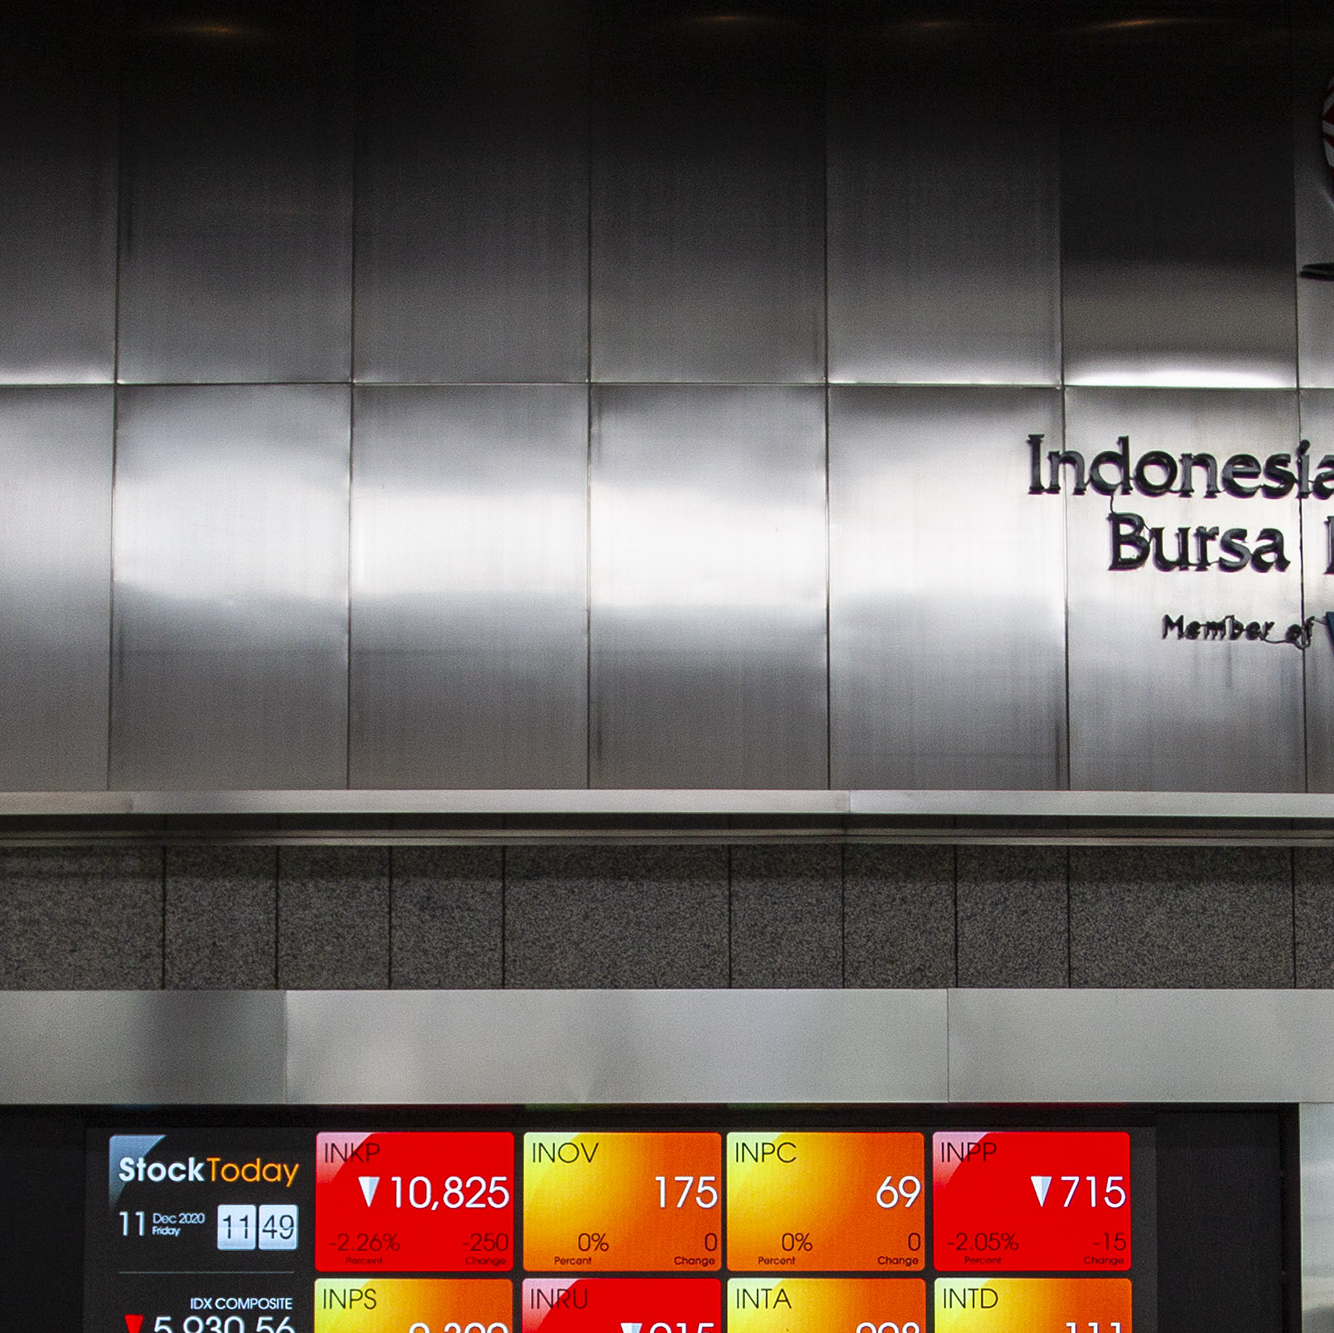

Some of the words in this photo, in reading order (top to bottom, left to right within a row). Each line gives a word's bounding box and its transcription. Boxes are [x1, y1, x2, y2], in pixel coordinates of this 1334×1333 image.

[1109, 512, 1290, 574] Bursa
[1162, 614, 1274, 640] Member
[1285, 617, 1313, 647] of
[324, 1143, 380, 1163] INKP
[532, 1142, 598, 1164] INOV
[735, 1142, 797, 1164] INPC
[940, 1142, 997, 1164] INPP
[391, 1176, 509, 1211] 10,825
[655, 1176, 717, 1209] 175
[875, 1176, 921, 1209] 69
[1060, 1175, 1126, 1209] 715
[119, 1212, 144, 1237] 11
[153, 1213, 179, 1224] Dec
[181, 1213, 205, 1224] 2020
[153, 1226, 180, 1237] Friday
[223, 1214, 250, 1240] 11
[262, 1214, 294, 1240] 49
[330, 1233, 400, 1253] -2.26%
[462, 1233, 509, 1253] -250
[578, 1233, 609, 1252] 0%
[705, 1233, 717, 1252] 0
[781, 1233, 812, 1252] 0%
[908, 1233, 921, 1252] 0
[947, 1232, 1019, 1251] -2.05%
[1093, 1233, 1126, 1251] -15
[345, 1256, 383, 1265] Percent
[465, 1256, 506, 1268] Change
[554, 1256, 592, 1266] Percent
[674, 1256, 715, 1267] Change
[758, 1256, 796, 1266] Percent
[878, 1256, 919, 1267] Change
[964, 1256, 1002, 1266] Percent
[1084, 1256, 1124, 1267] Change
[190, 1298, 212, 1309] IDX
[215, 1298, 293, 1310] COMPOSITE
[323, 1289, 377, 1310] INPS
[530, 1288, 588, 1310] INRU
[735, 1288, 792, 1310] INTA
[943, 1288, 999, 1310] INTD
